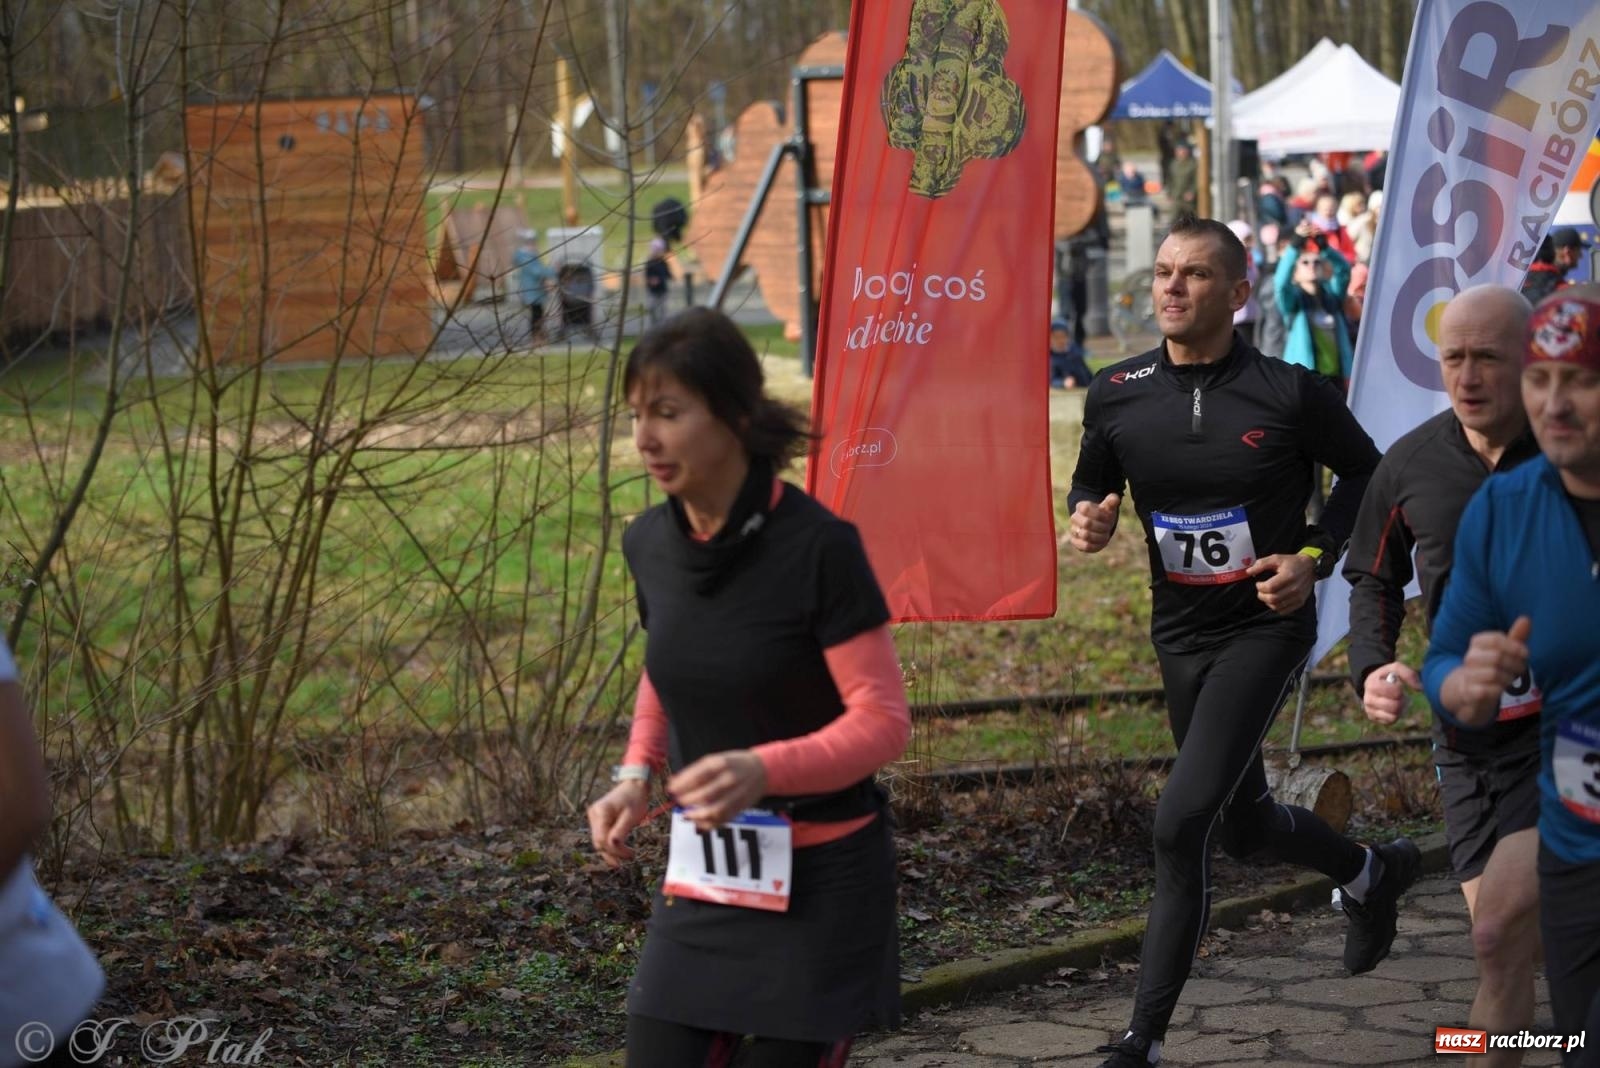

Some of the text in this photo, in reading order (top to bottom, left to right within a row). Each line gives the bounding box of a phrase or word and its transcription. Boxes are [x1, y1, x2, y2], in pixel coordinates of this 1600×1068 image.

[1508, 37, 1600, 271] RACIBÓRZ
[923, 268, 987, 302] coś
[1184, 512, 1233, 524] TWARDZIELA
[1173, 530, 1230, 569] 76
[695, 826, 762, 881] 111
